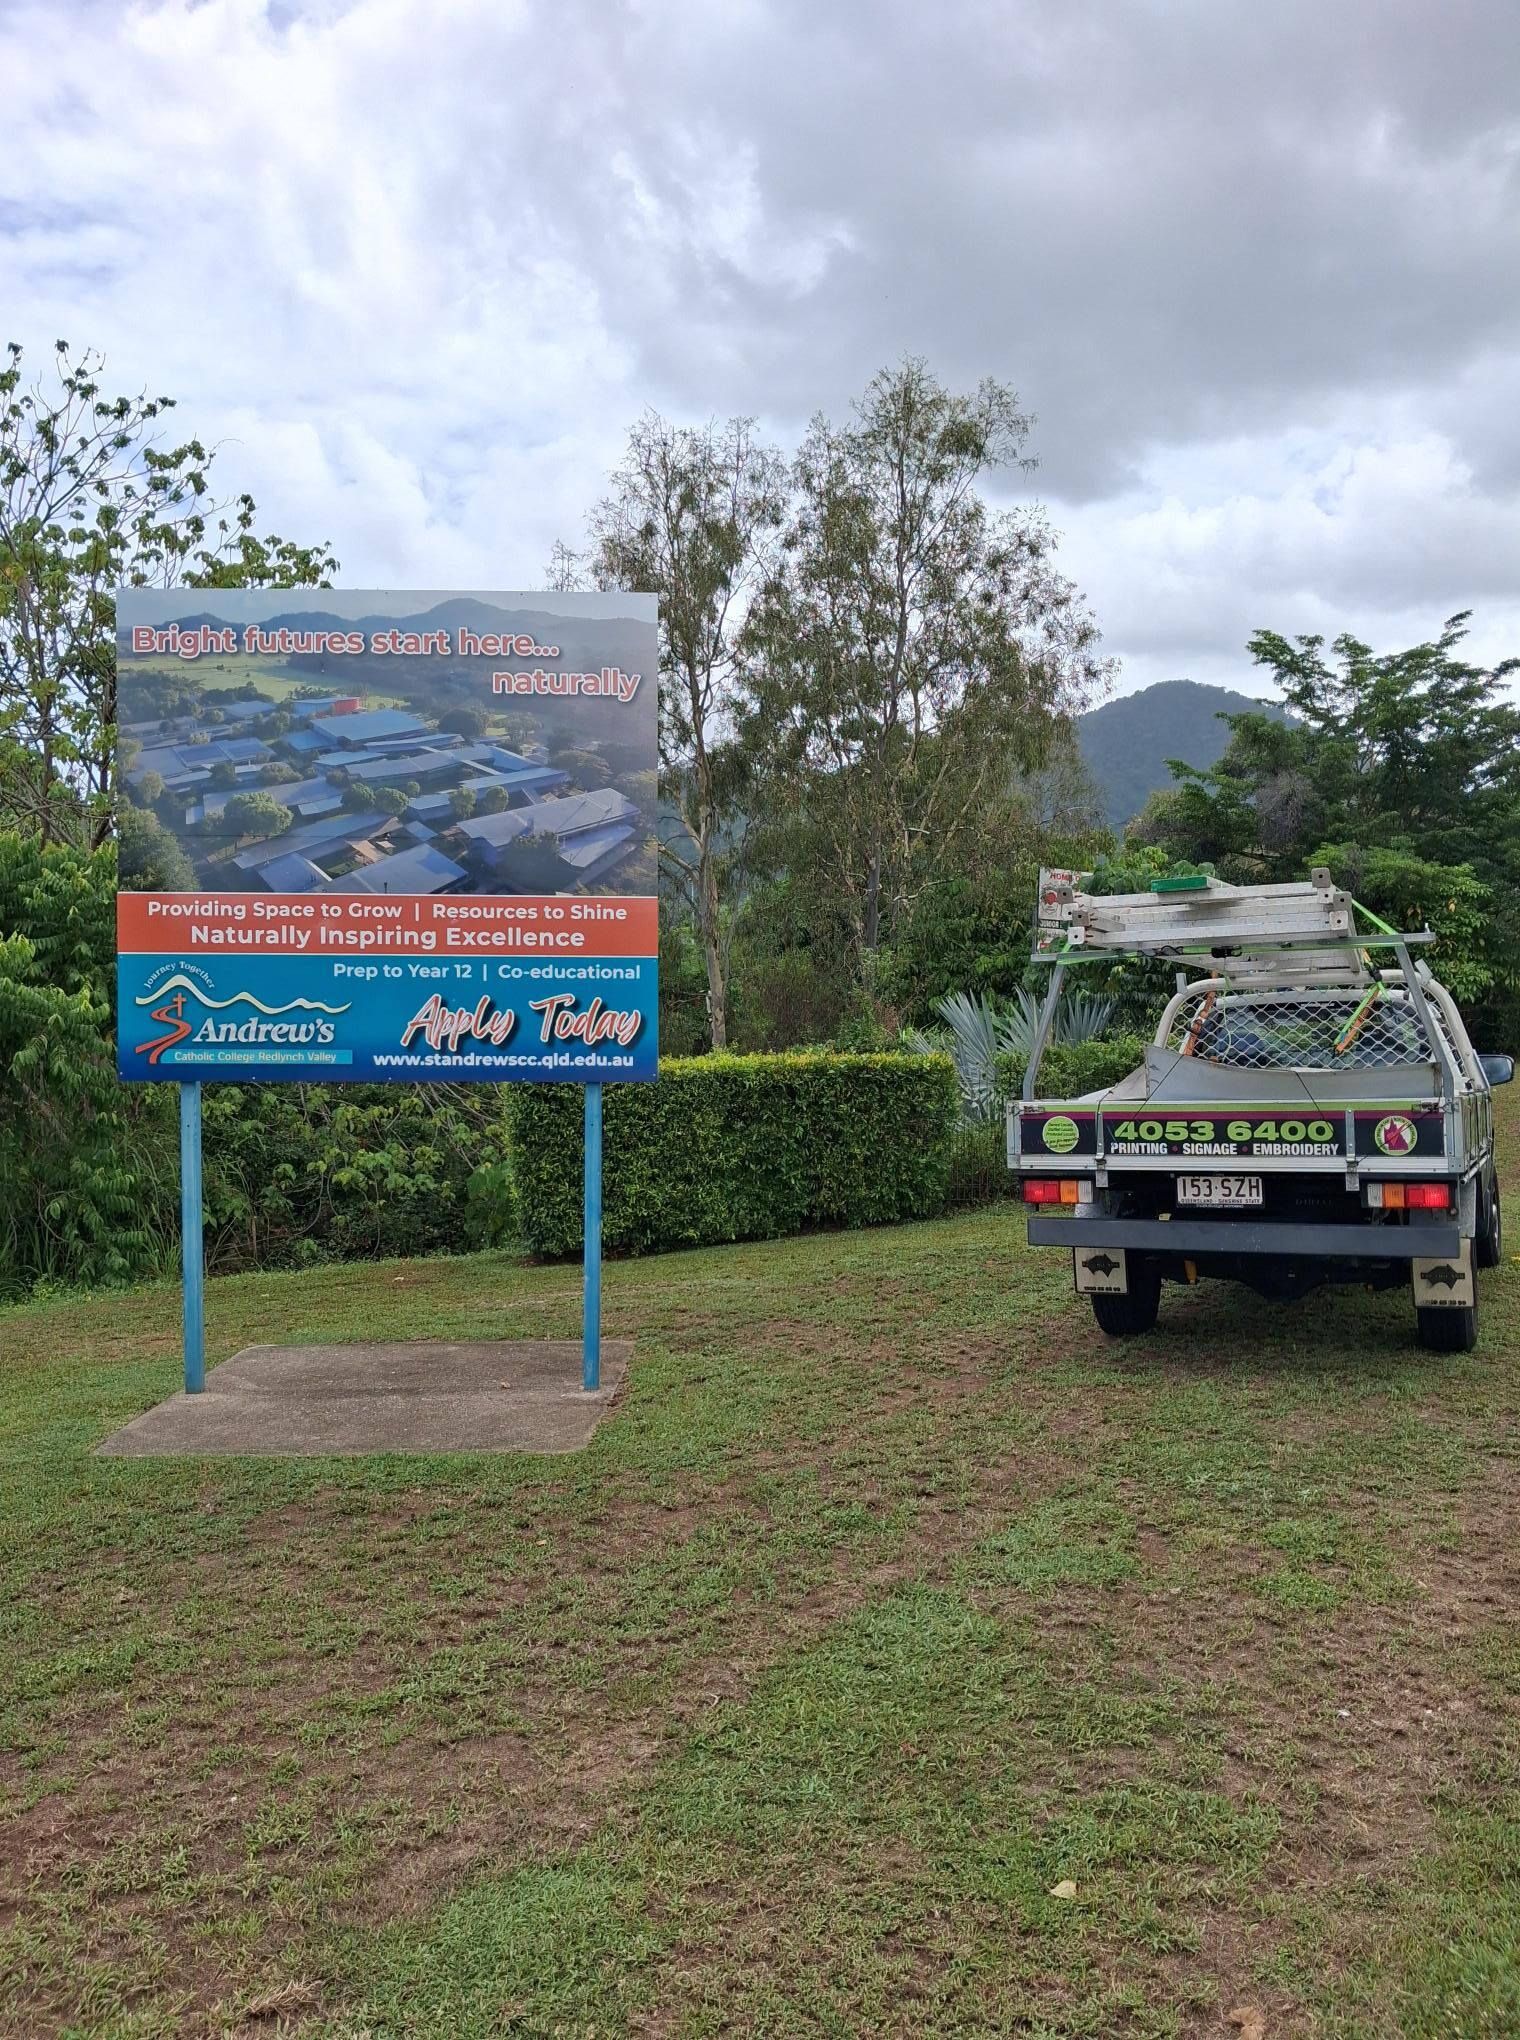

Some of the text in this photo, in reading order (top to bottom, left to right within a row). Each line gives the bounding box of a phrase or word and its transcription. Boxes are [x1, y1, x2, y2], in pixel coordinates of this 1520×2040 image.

[133, 623, 560, 659] Bright futures start here...
[492, 667, 641, 702] naturally
[148, 900, 628, 920] Providing Space to Grow Resources to Shine
[191, 925, 584, 950] Naturally Inspiring Excellence
[144, 961, 215, 989] Journey Together
[333, 963, 641, 980] Prep to Year 12 Co-educational
[192, 1017, 335, 1044] Andrew's
[400, 993, 641, 1051] Apply Today
[174, 1051, 336, 1064] Catholic College Redlynch Valley
[373, 1052, 634, 1069] www.standrewscc.qld.edu.au
[1114, 1120, 1334, 1141] 4053 6400
[1111, 1142, 1339, 1156] PRINTING SIGNAGE EMBROIDERY
